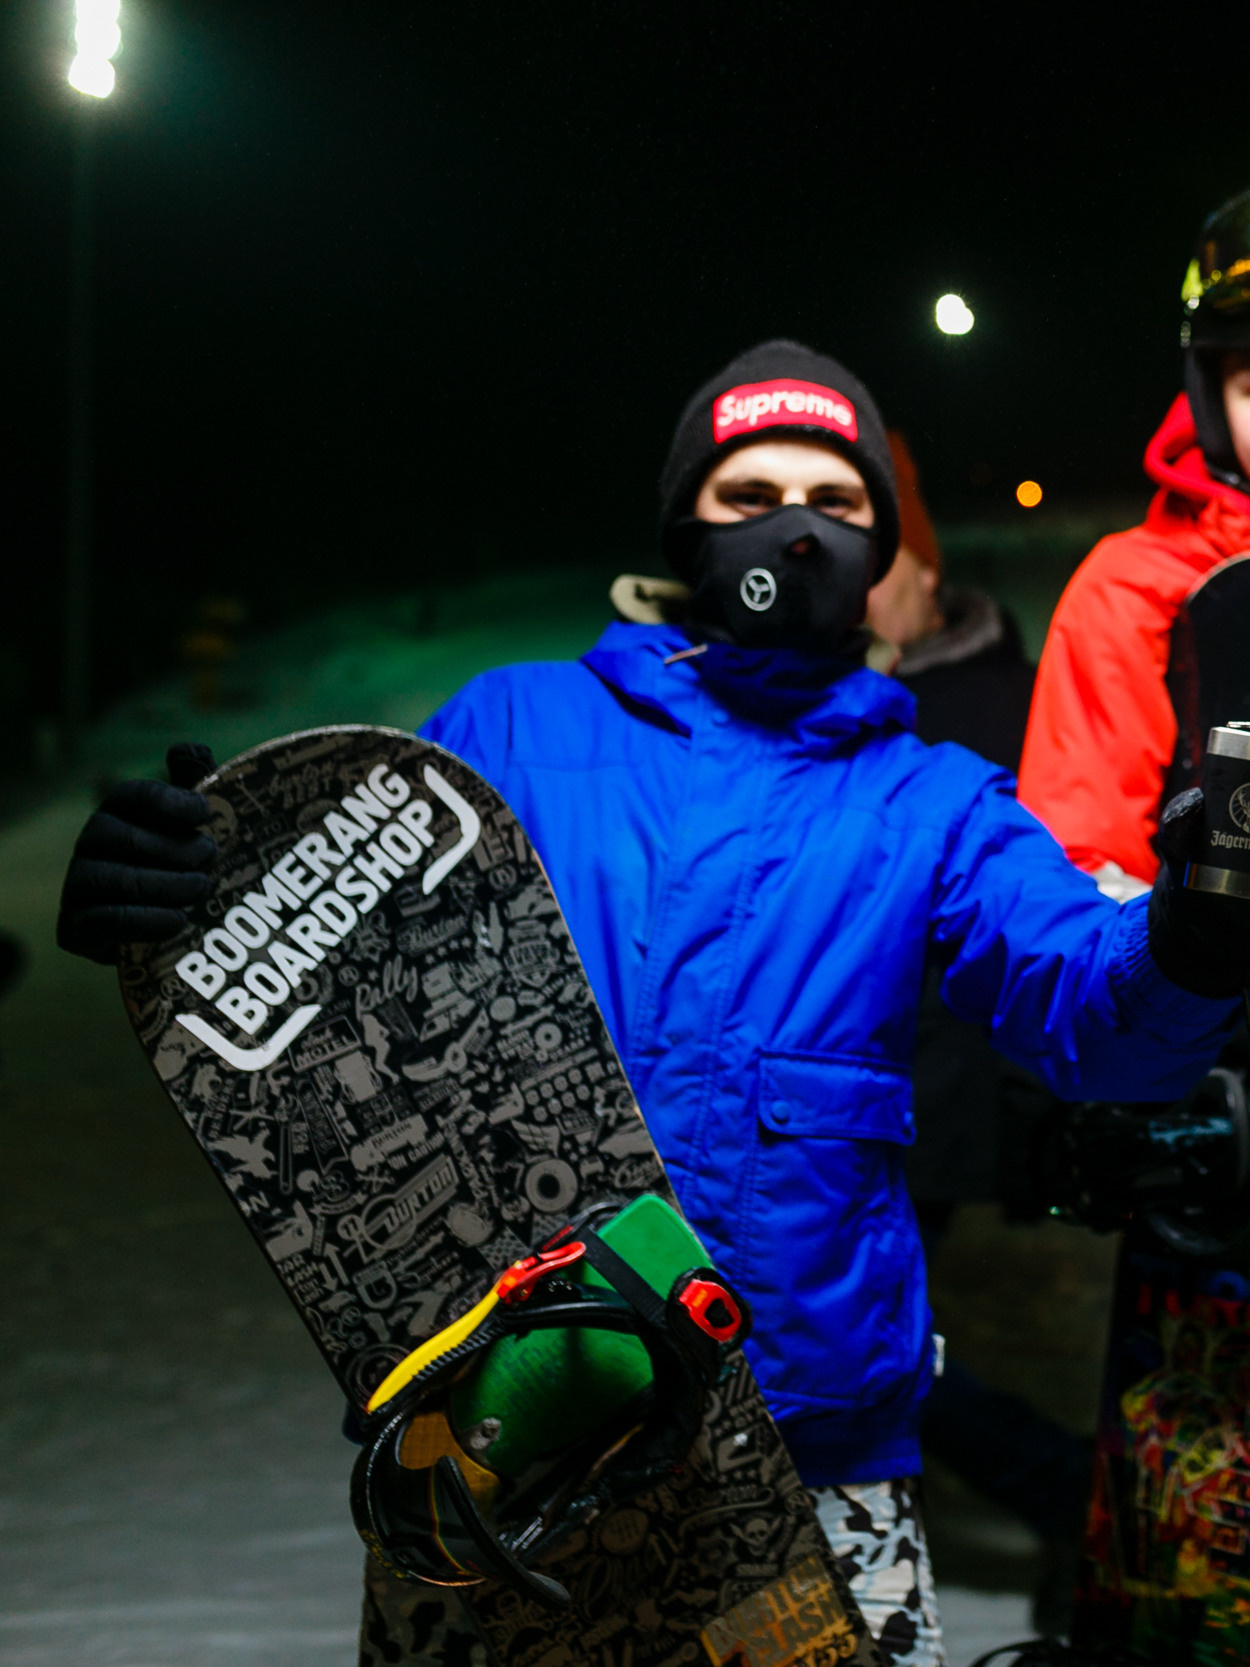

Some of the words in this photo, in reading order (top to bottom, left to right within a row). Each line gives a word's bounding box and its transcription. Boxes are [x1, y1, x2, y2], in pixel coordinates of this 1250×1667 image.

[717, 390, 852, 427] Supreme
[175, 764, 411, 1001] BOOMERANG
[214, 799, 434, 1035] BOARDSHOP
[297, 1034, 353, 1068] MOTEL
